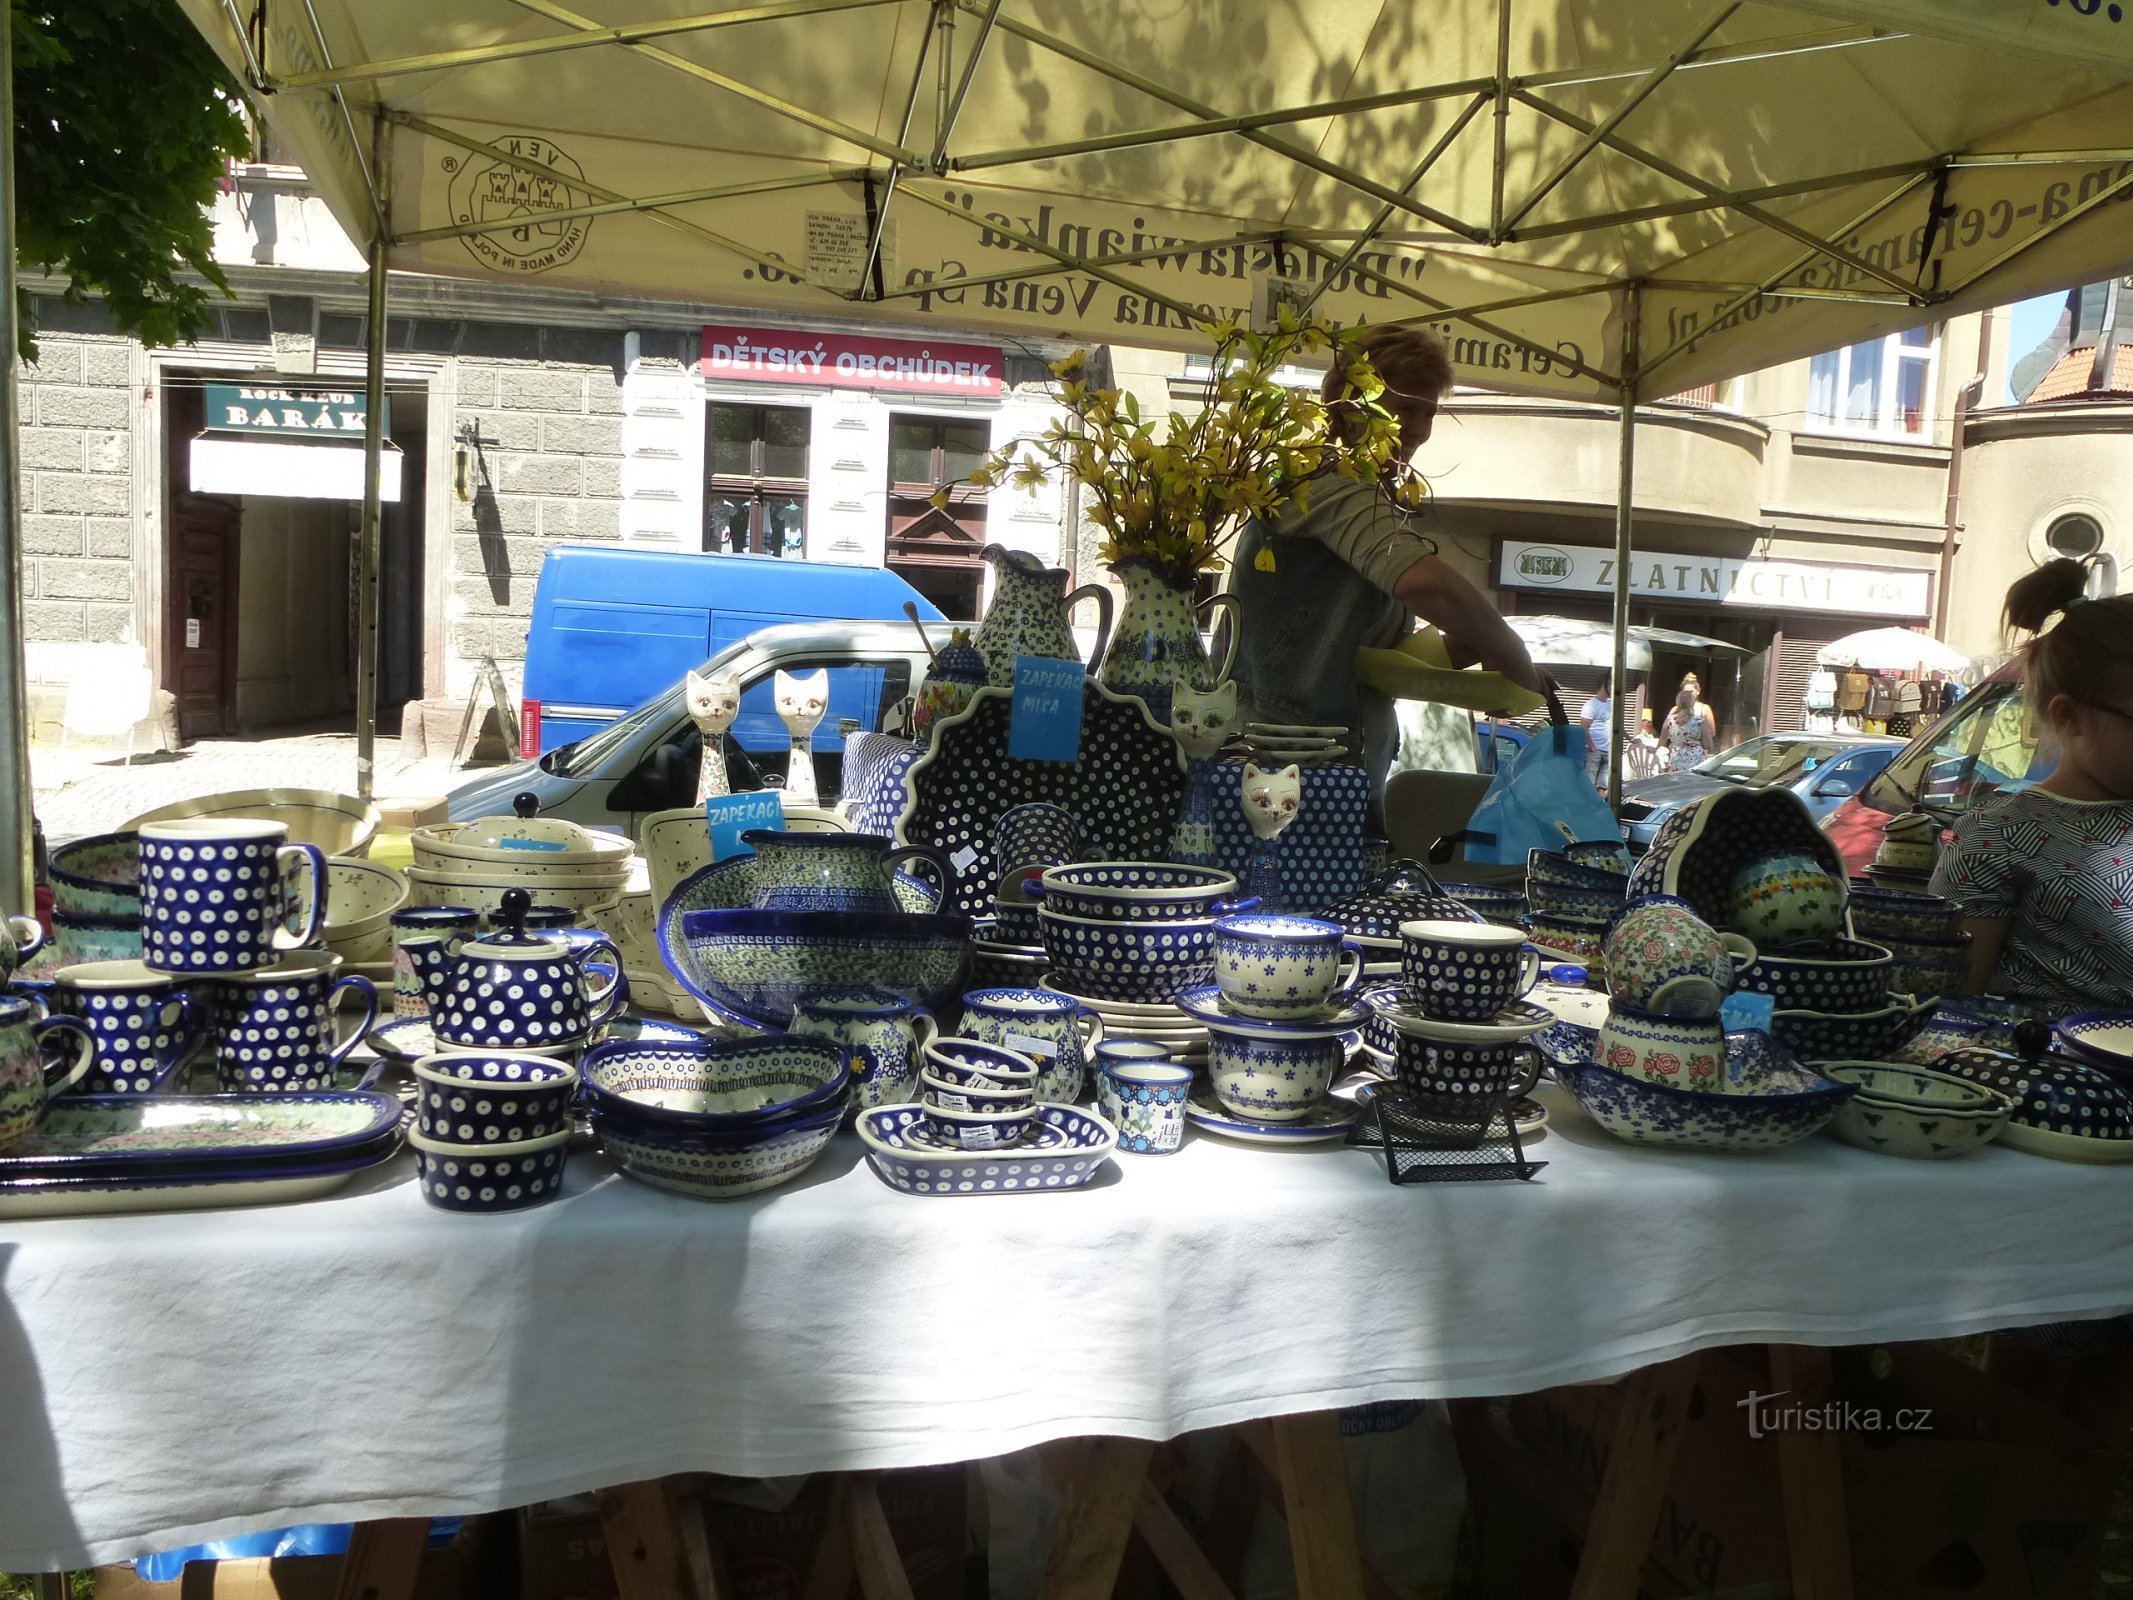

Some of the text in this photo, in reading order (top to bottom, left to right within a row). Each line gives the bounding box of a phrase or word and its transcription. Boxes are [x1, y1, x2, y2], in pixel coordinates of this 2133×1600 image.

[712, 335, 992, 388] DĚTSKÝ OBCHŮDEK
[239, 388, 355, 404] ROCK KLUB
[225, 405, 367, 431] BARÁK
[1595, 559, 1834, 601] ZLATNICTVÍ
